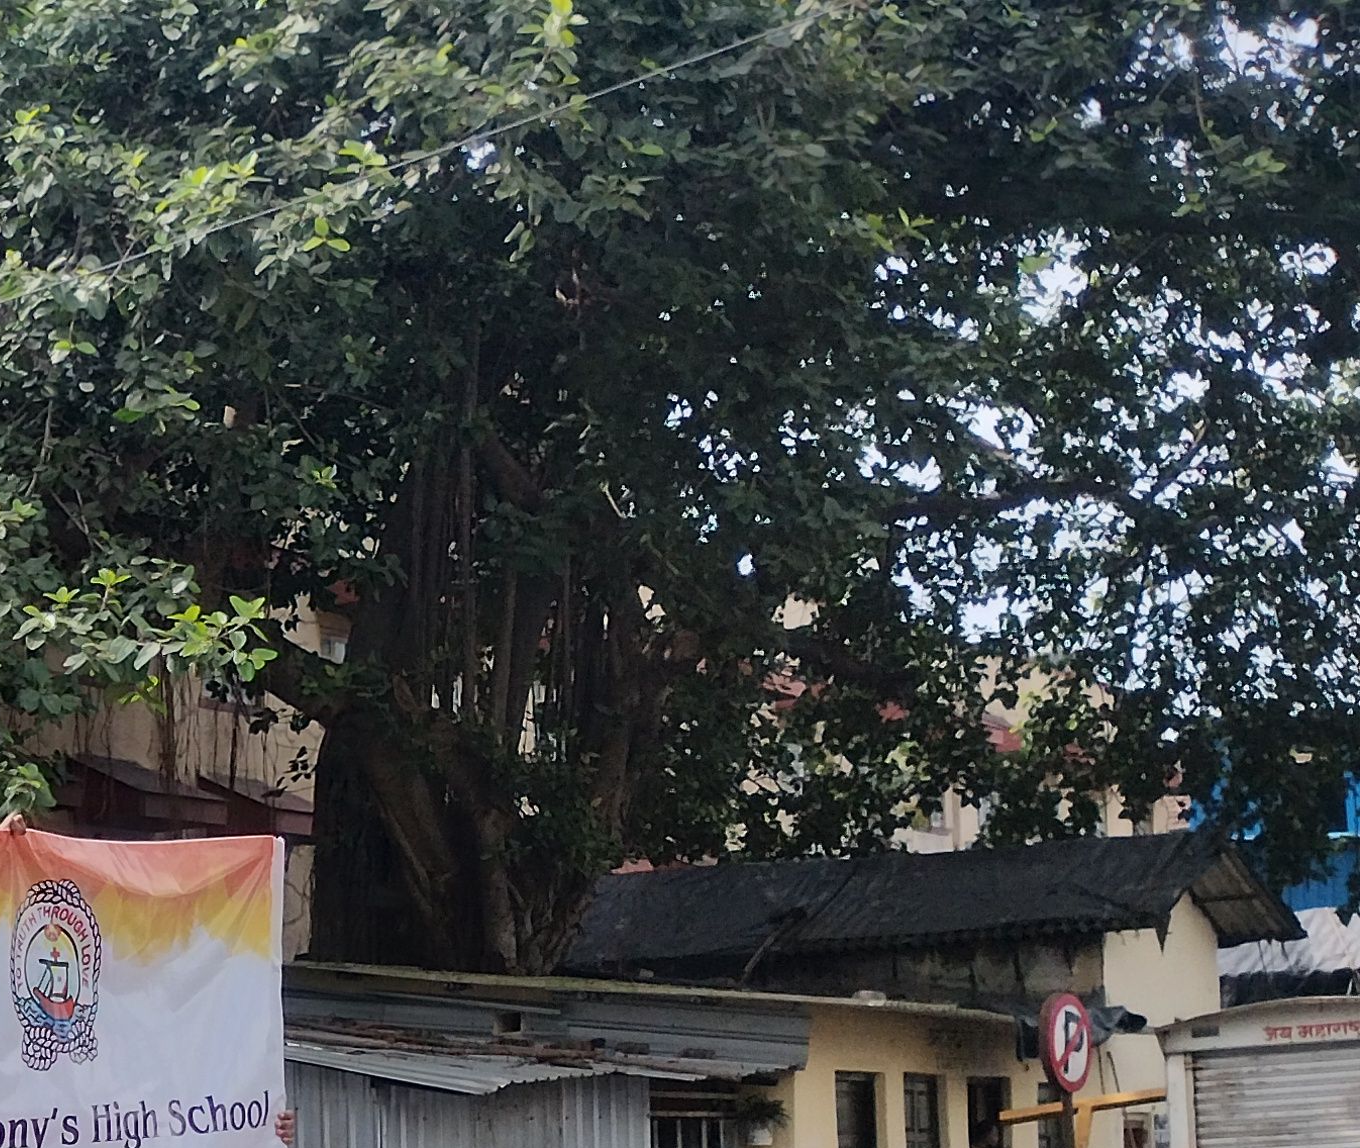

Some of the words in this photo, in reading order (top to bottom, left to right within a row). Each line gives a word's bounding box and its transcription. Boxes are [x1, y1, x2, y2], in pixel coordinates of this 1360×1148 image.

[37, 905, 90, 941] THROUGH
[80, 943, 92, 989] LOVE
[167, 1090, 270, 1136] School
